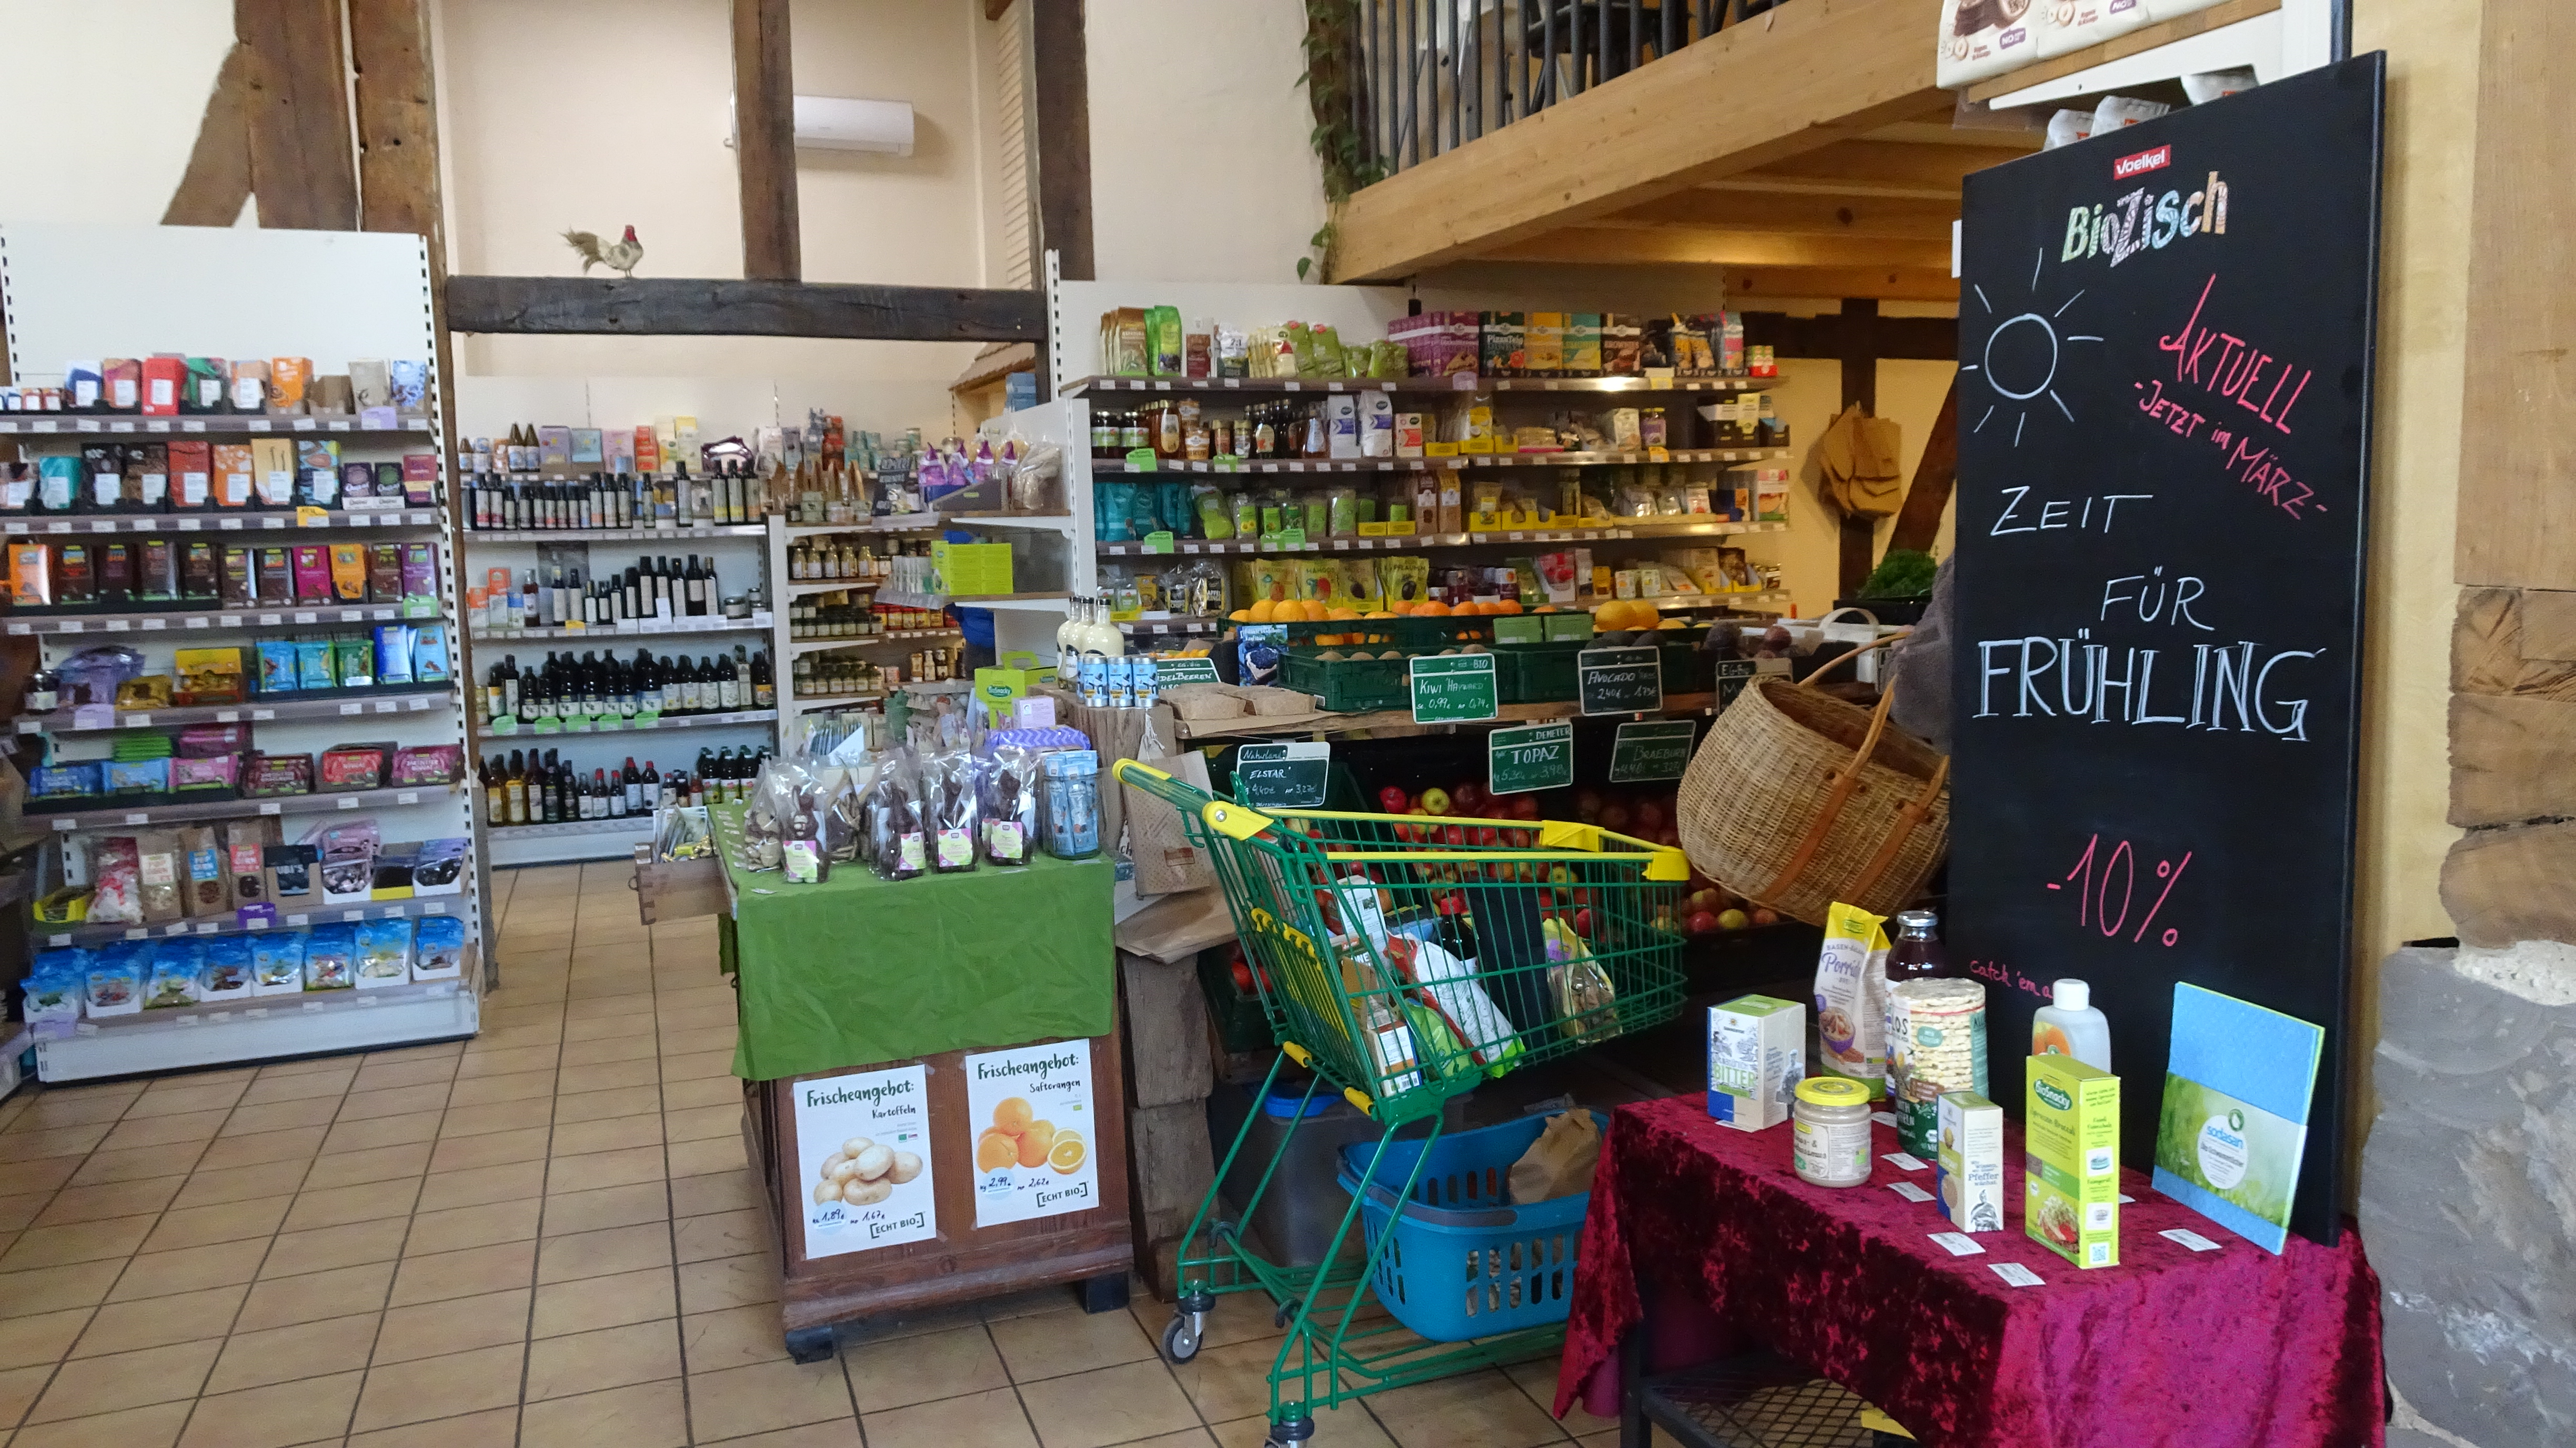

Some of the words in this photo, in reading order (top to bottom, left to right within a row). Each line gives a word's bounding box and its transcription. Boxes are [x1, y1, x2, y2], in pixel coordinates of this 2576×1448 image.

[2116, 149, 2165, 175] Voelkel
[2061, 171, 2228, 267] BioZisch
[2159, 274, 2311, 434] AKTUELL
[1991, 486, 2153, 536] ZEIT
[2101, 566, 2215, 630] FÜR
[1420, 679, 1442, 694] KIWI
[1588, 671, 1636, 685] AVOCADO
[1973, 628, 2327, 741] FRÜHLING
[1536, 727, 1570, 740] DEMETER
[1511, 746, 1559, 764] TOPAZ
[1250, 769, 1286, 779] ELSTAR
[978, 1053, 1079, 1081] Frischeangebot:
[1714, 1062, 1756, 1088] BITTER
[807, 1079, 914, 1108] Frischeangebot:
[1030, 1078, 1081, 1093] Saftorangen
[2036, 1080, 2070, 1110] BioSnacky
[872, 1105, 916, 1120] Kartoffeln
[2207, 1125, 2243, 1150] sodasan
[1968, 1172, 1999, 1181] Pfeffer
[1042, 1192, 1063, 1203] ECHT
[876, 1223, 897, 1234] ECHT
